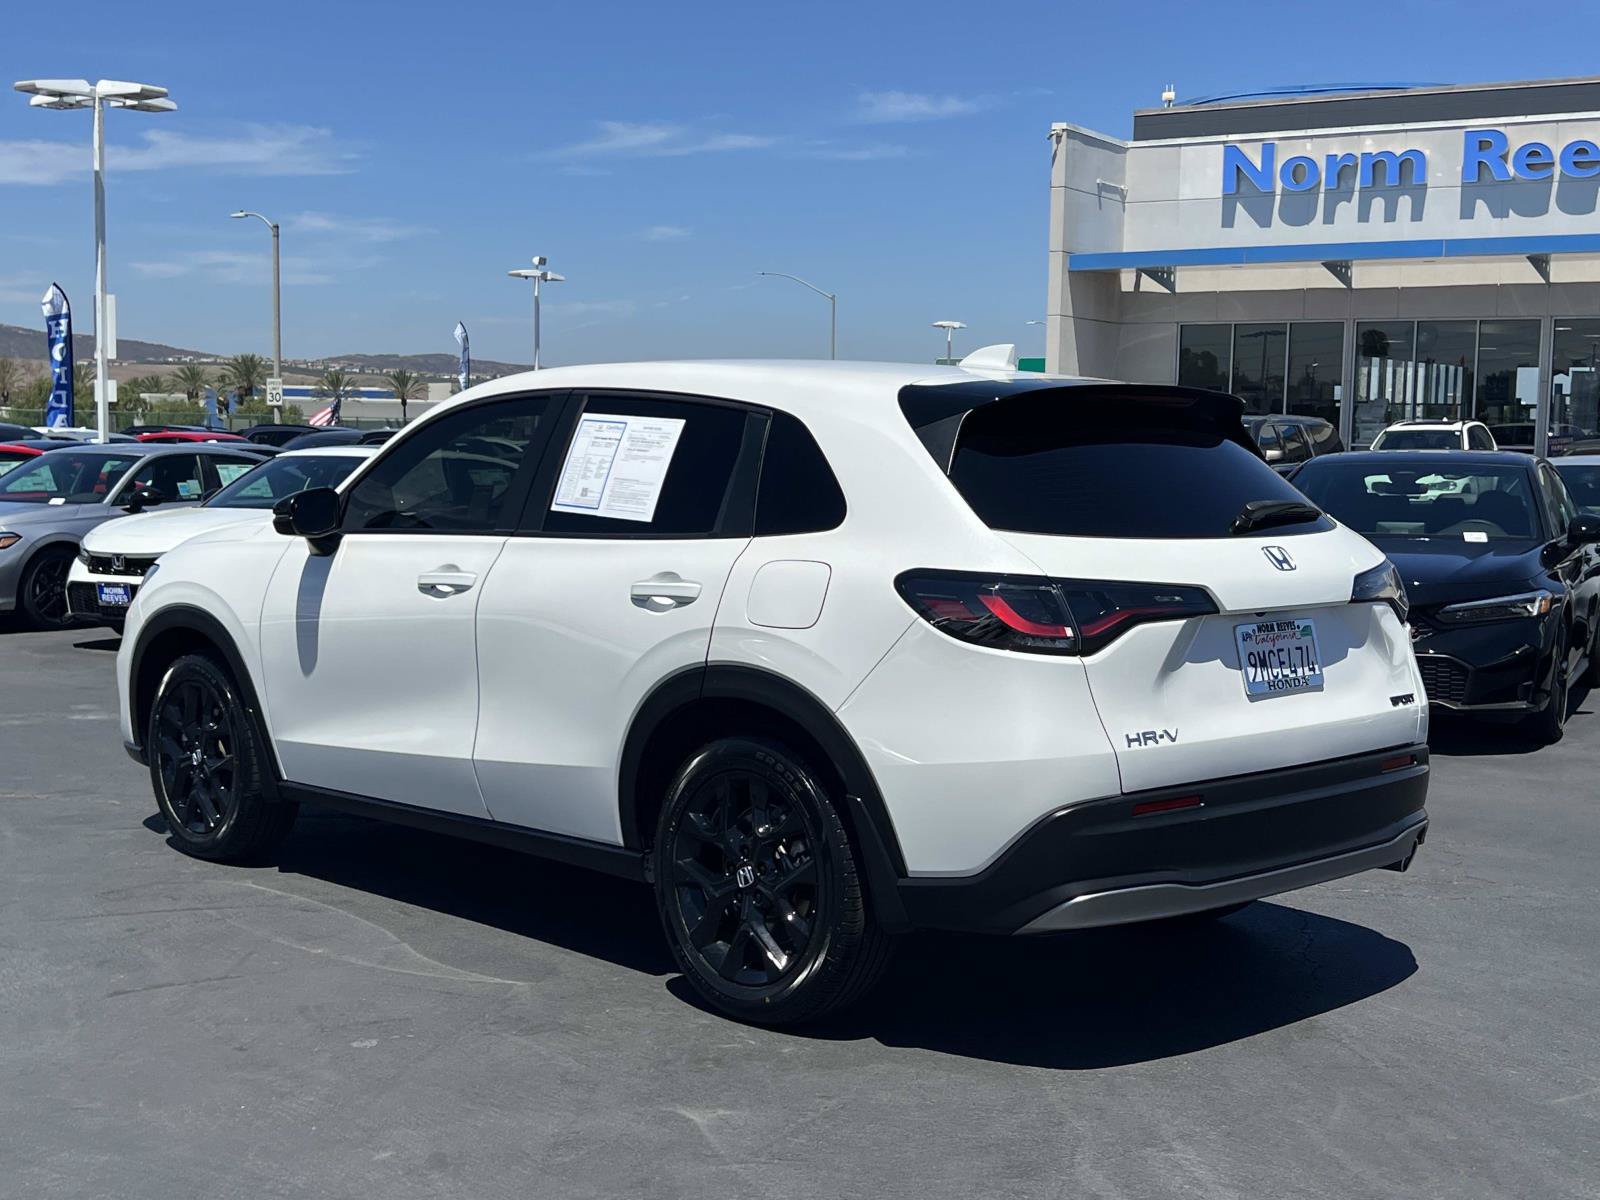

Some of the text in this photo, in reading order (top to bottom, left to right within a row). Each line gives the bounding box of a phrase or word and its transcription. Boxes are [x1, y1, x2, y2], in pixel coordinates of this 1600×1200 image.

[1222, 129, 1600, 195] Norm Ree
[268, 392, 282, 403] 30
[101, 594, 128, 602] REEVES
[1256, 622, 1276, 634] NORM
[1276, 620, 1297, 632] REEVES
[1255, 631, 1302, 648] California
[1248, 645, 1317, 682] 9MCE474
[1267, 676, 1310, 691] HONDA
[1125, 728, 1179, 748] HR-V
